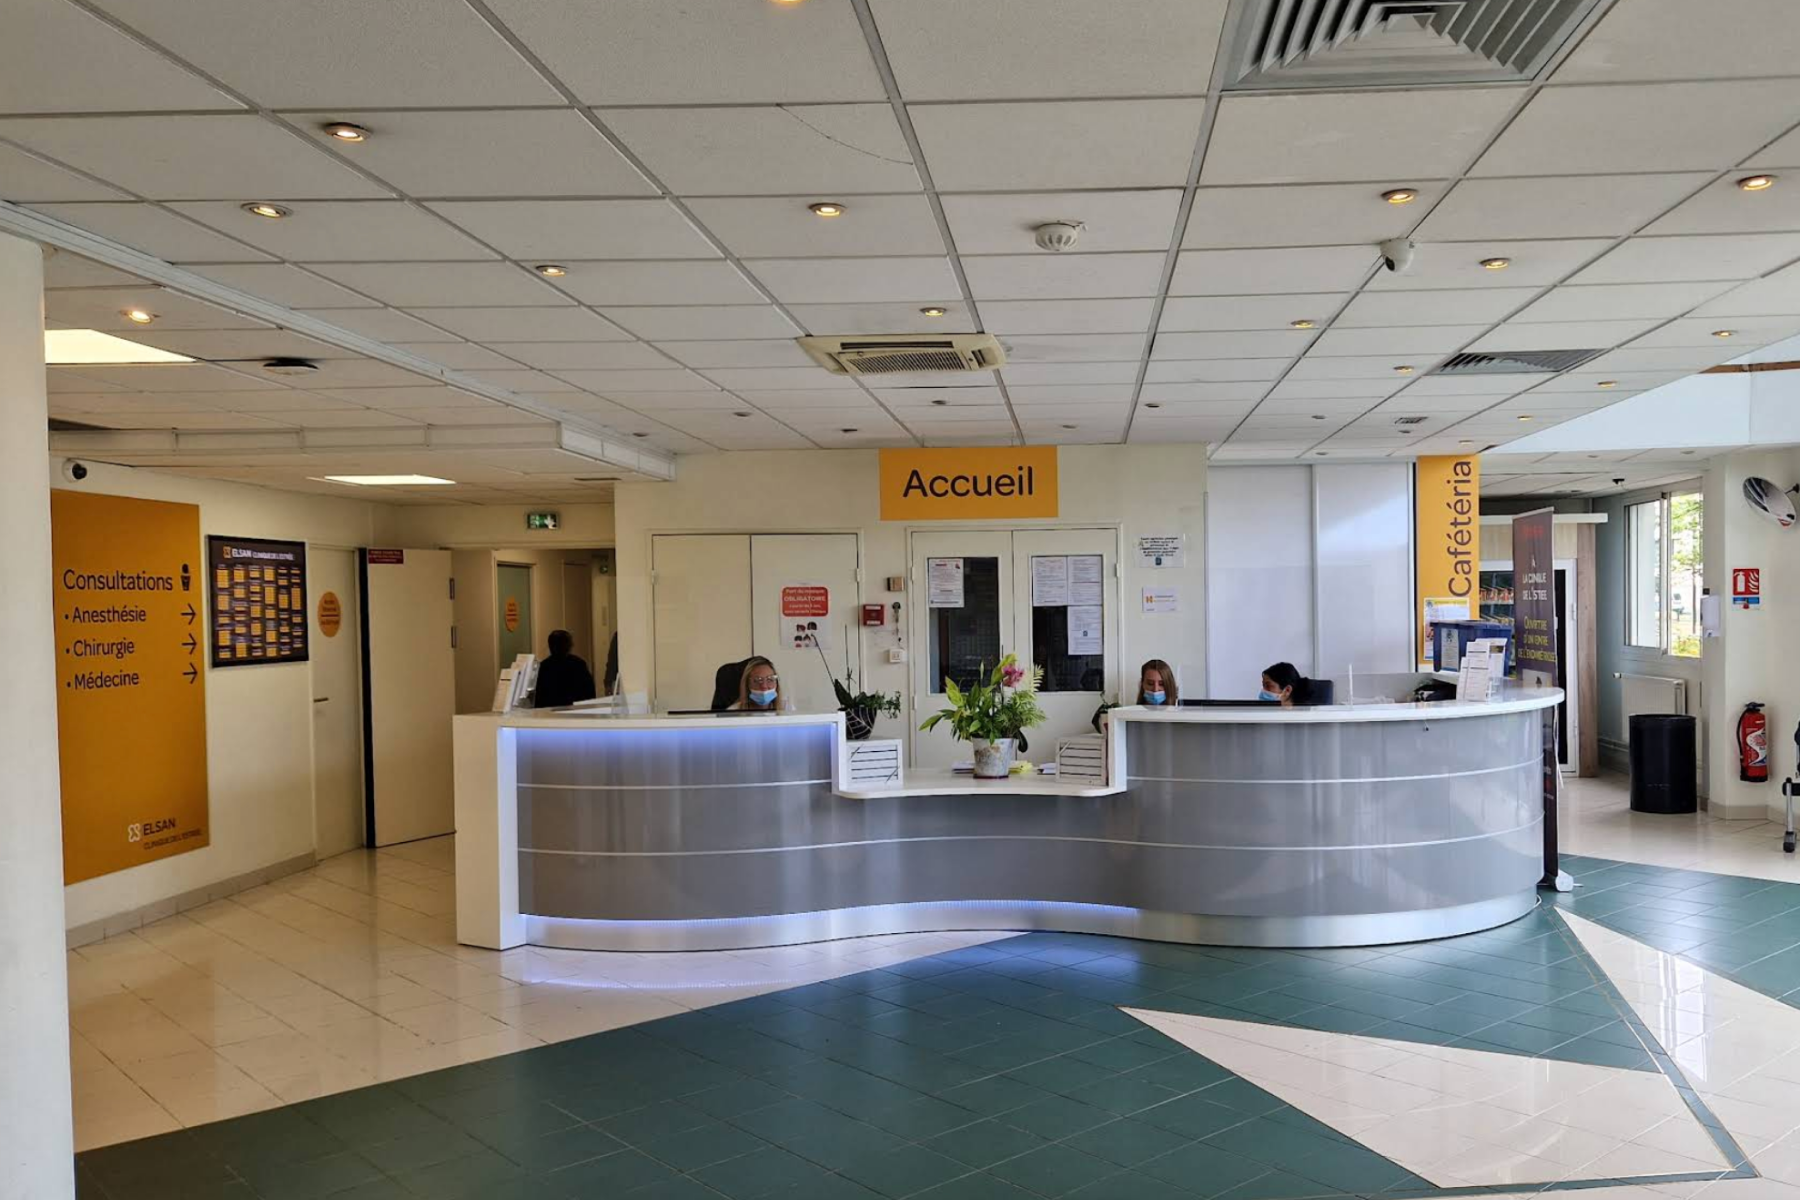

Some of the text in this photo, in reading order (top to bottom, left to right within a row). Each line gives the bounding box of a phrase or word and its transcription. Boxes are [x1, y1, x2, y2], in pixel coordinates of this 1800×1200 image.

[903, 466, 1033, 497] Accueil
[1446, 461, 1472, 597] Cafétéria
[63, 569, 173, 591] Consultations
[72, 605, 147, 624] Anesthésie
[73, 639, 135, 660] Chirurgie
[74, 670, 140, 690] Médecine
[143, 818, 176, 836] ELSAN
